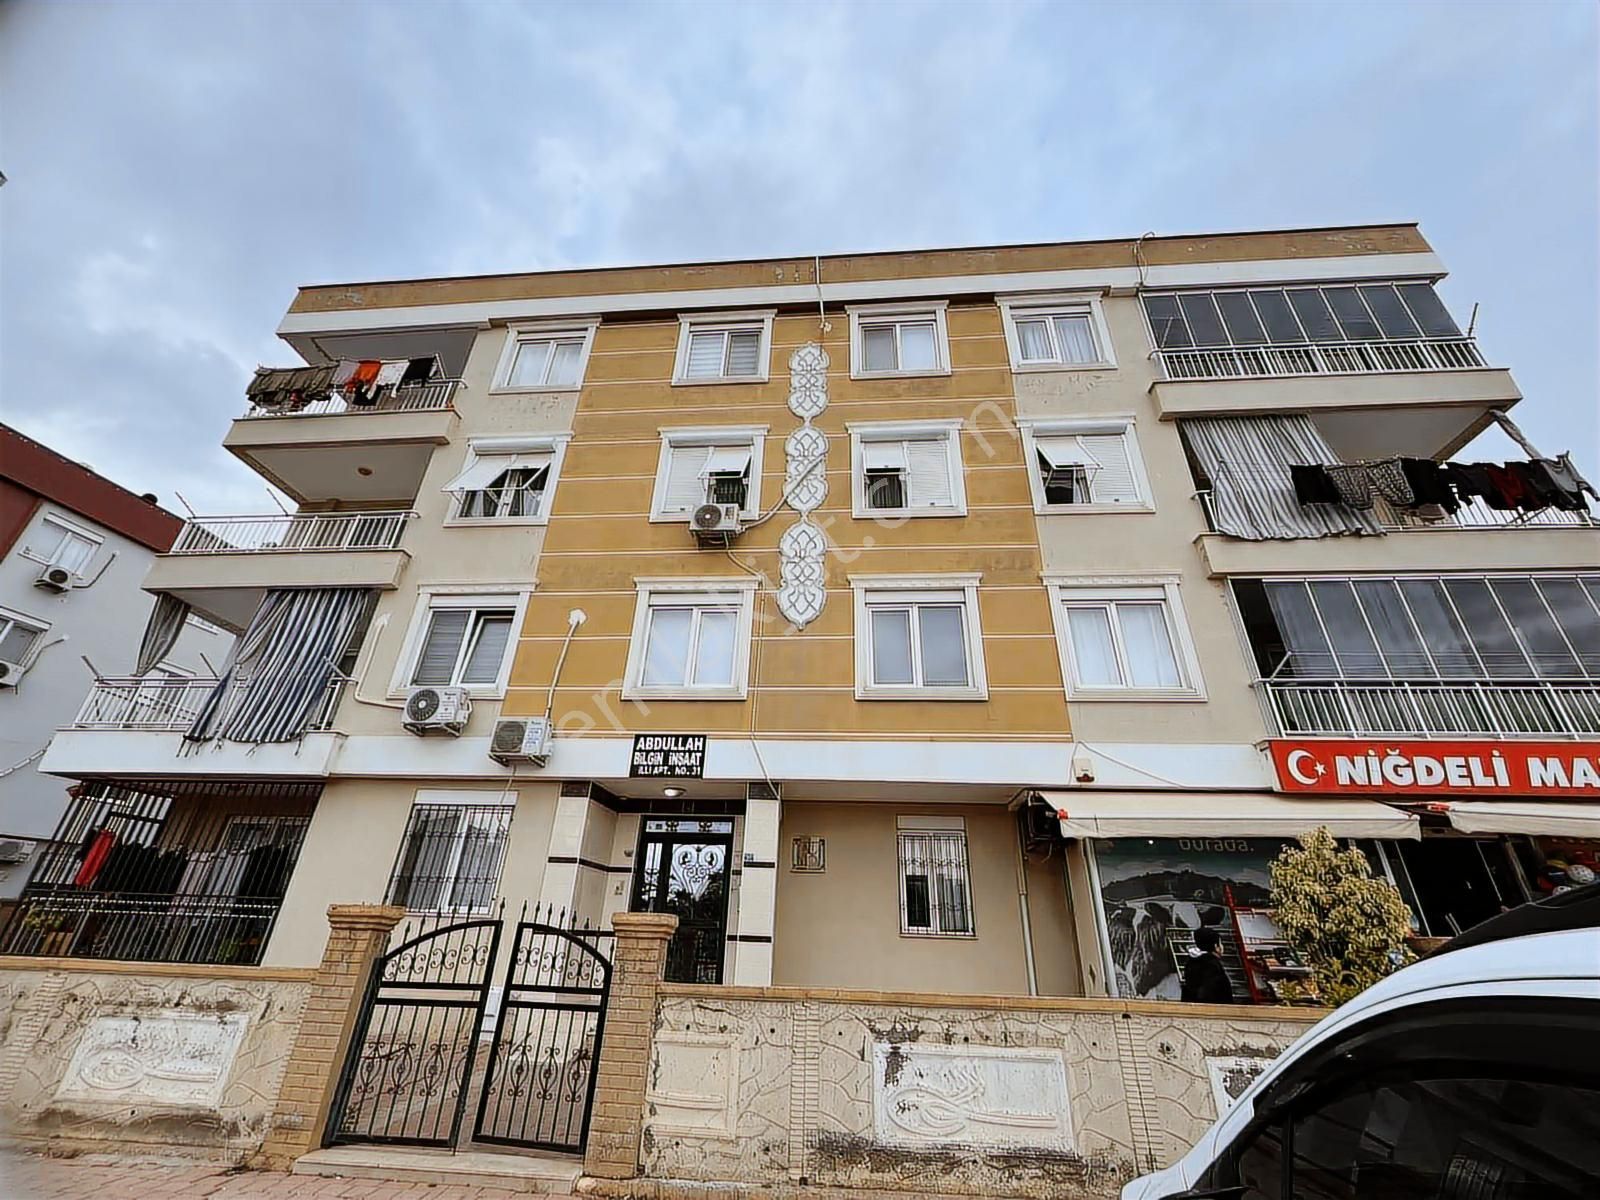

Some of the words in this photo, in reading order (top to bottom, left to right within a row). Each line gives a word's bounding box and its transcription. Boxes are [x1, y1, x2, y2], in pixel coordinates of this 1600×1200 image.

[636, 736, 704, 751] ABDULLAH
[1335, 749, 1510, 787] NİĞDELİ
[1527, 757, 1600, 788] MA
